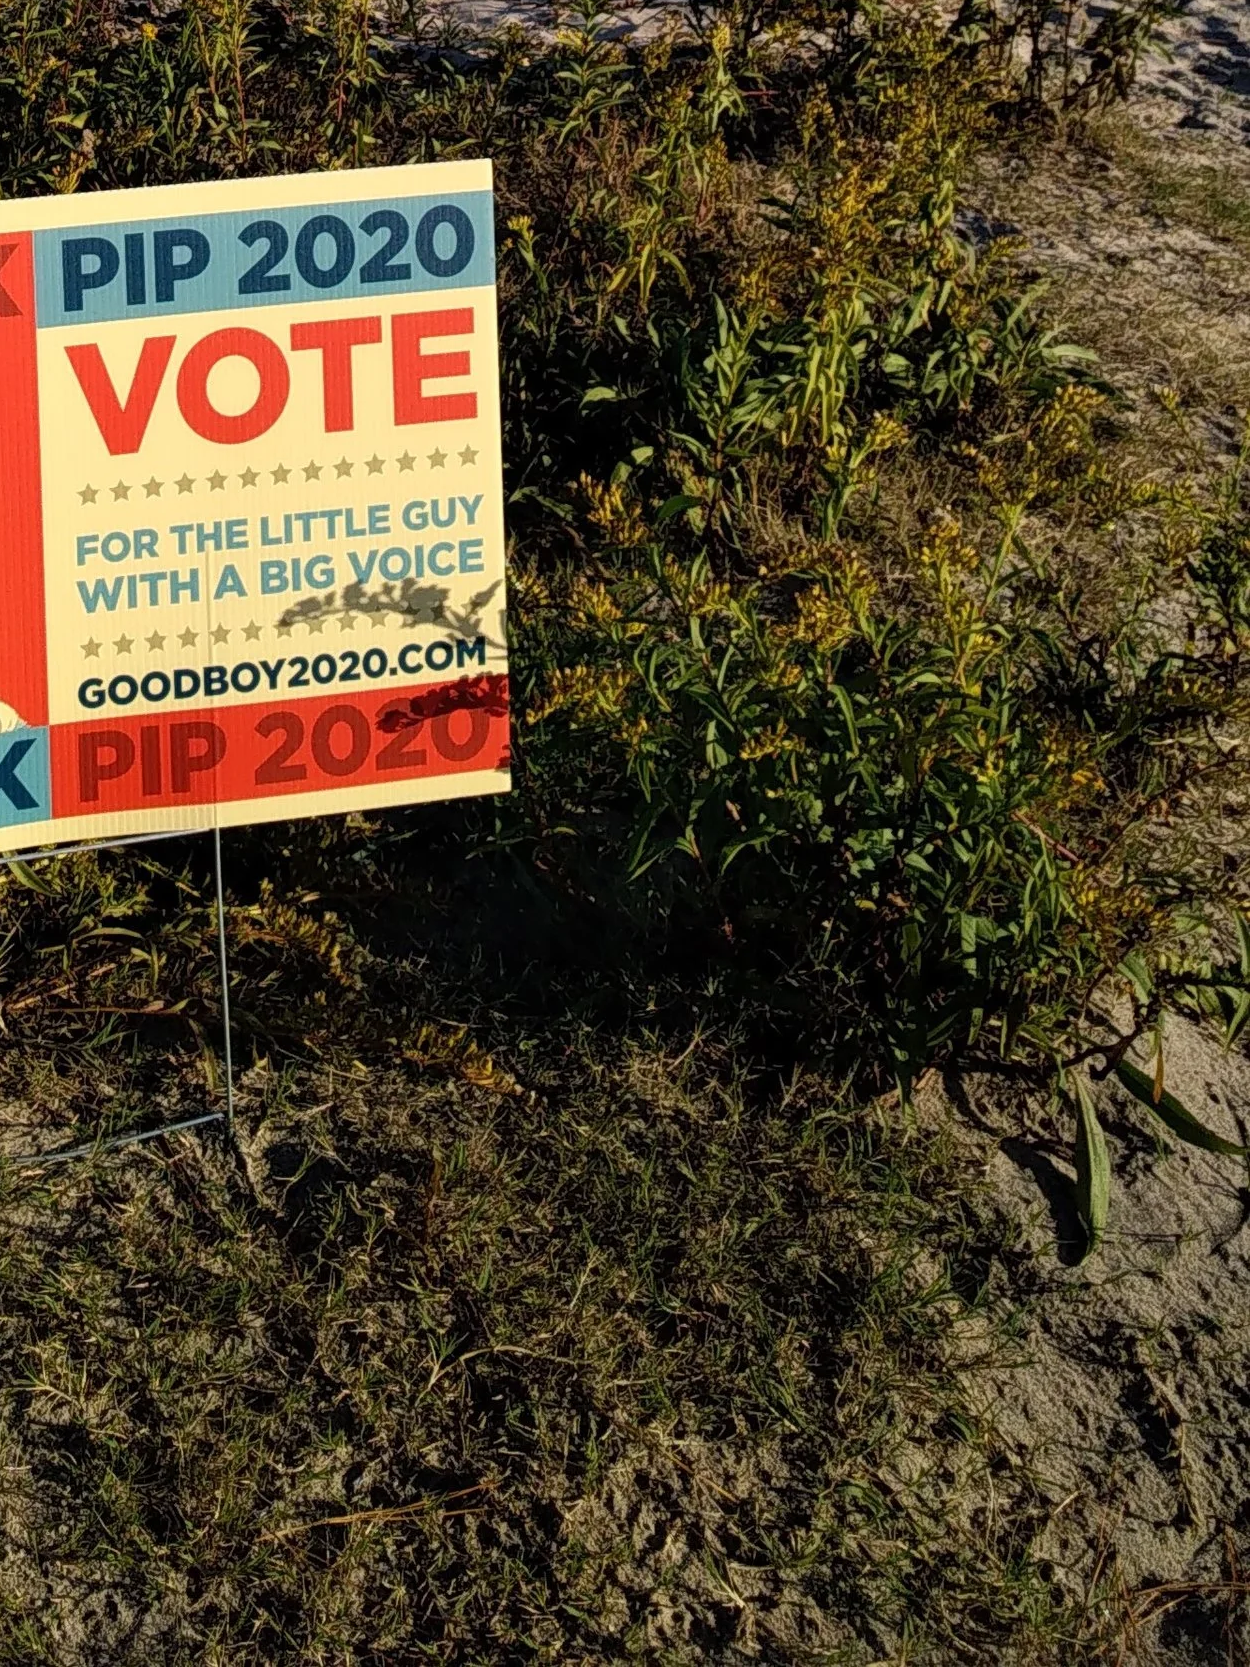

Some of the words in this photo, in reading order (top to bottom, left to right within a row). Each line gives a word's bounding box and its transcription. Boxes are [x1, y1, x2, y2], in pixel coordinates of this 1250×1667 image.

[61, 229, 210, 312] PIP
[237, 204, 475, 295] 2020
[64, 307, 478, 456] VOTE
[75, 526, 159, 566] FOR
[170, 517, 249, 555] THE
[260, 504, 391, 547] LITTLE
[402, 494, 484, 531] GUY
[77, 565, 200, 614] WITH
[213, 564, 248, 599] A
[260, 553, 335, 595] BIG
[349, 538, 485, 586] VOICE
[78, 636, 486, 708] GOODBOY2020.COM
[77, 720, 226, 803] PIP
[254, 693, 490, 785] 2020
